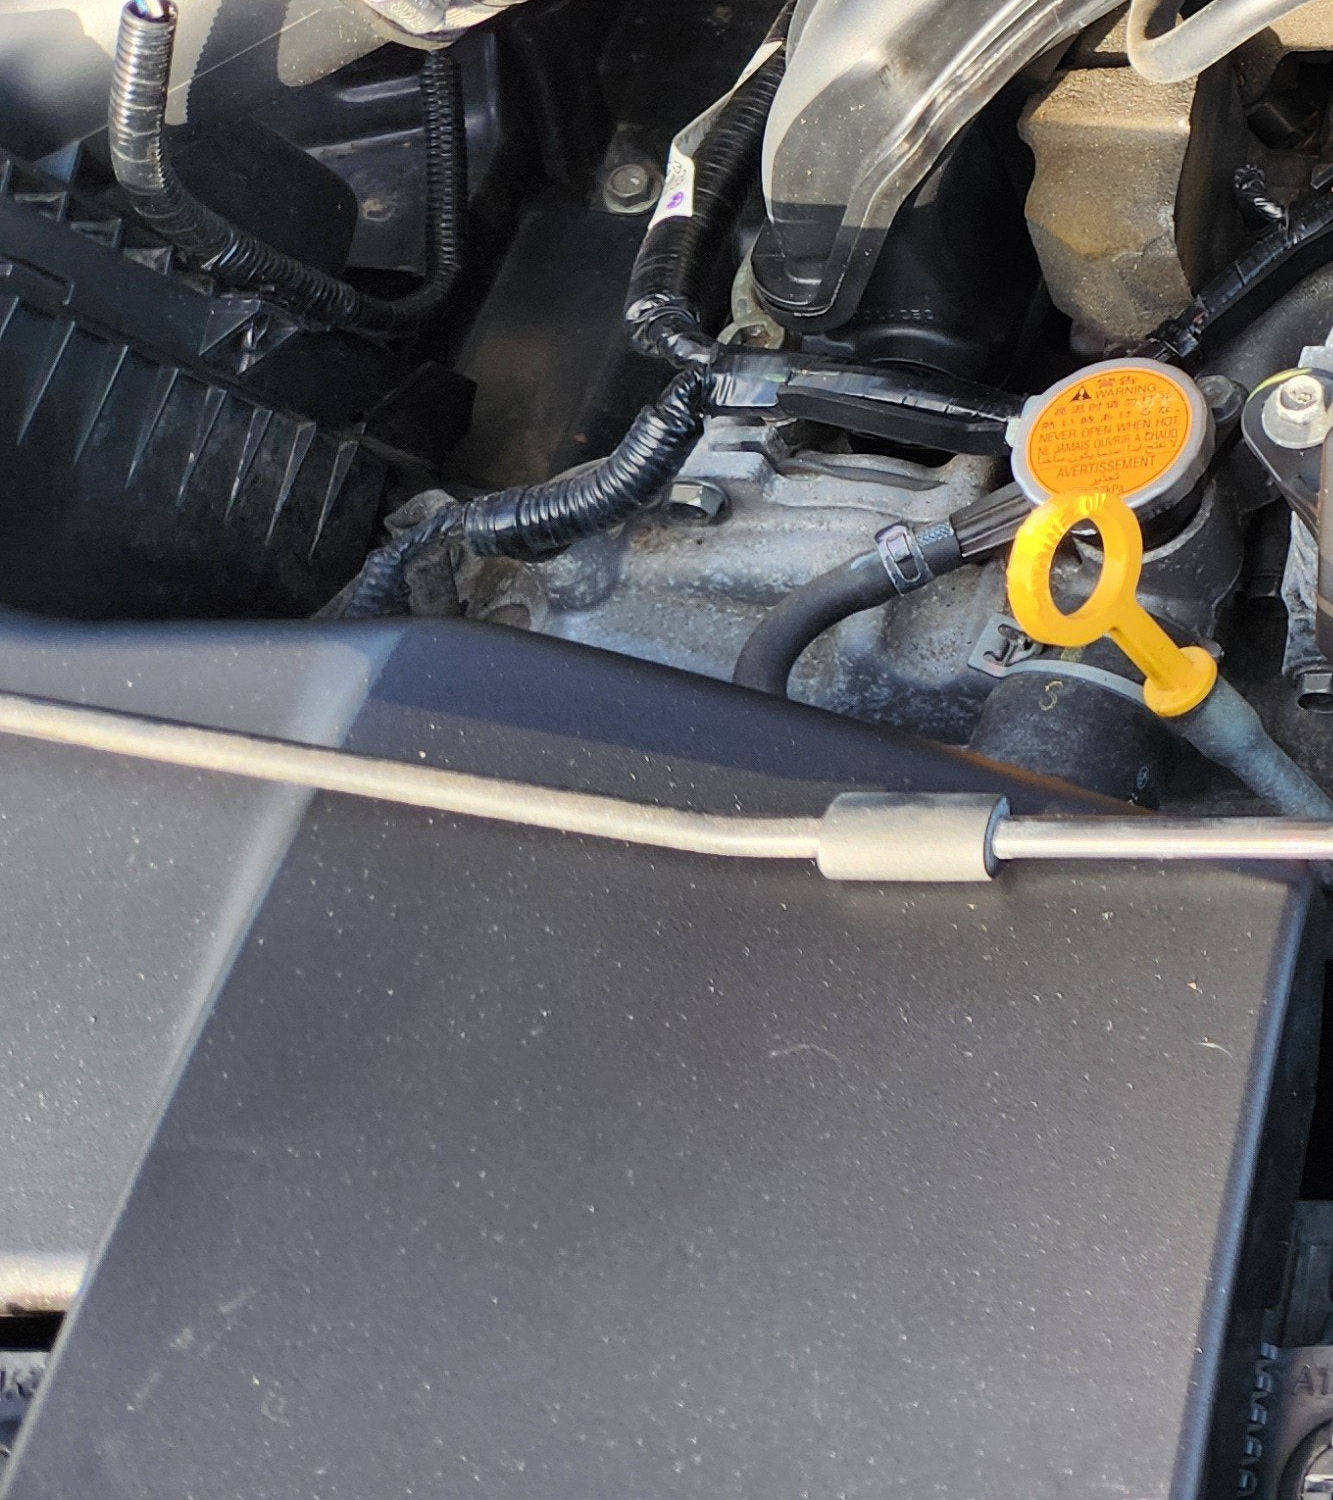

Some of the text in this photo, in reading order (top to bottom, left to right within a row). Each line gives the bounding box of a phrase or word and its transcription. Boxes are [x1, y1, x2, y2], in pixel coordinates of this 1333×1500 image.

[1095, 384, 1157, 399] WARNING
[1039, 429, 1080, 443] NEVER
[1081, 424, 1112, 438] OPEN
[1117, 418, 1151, 432] WHEN
[1057, 455, 1156, 479] AVERTISSEMENT
